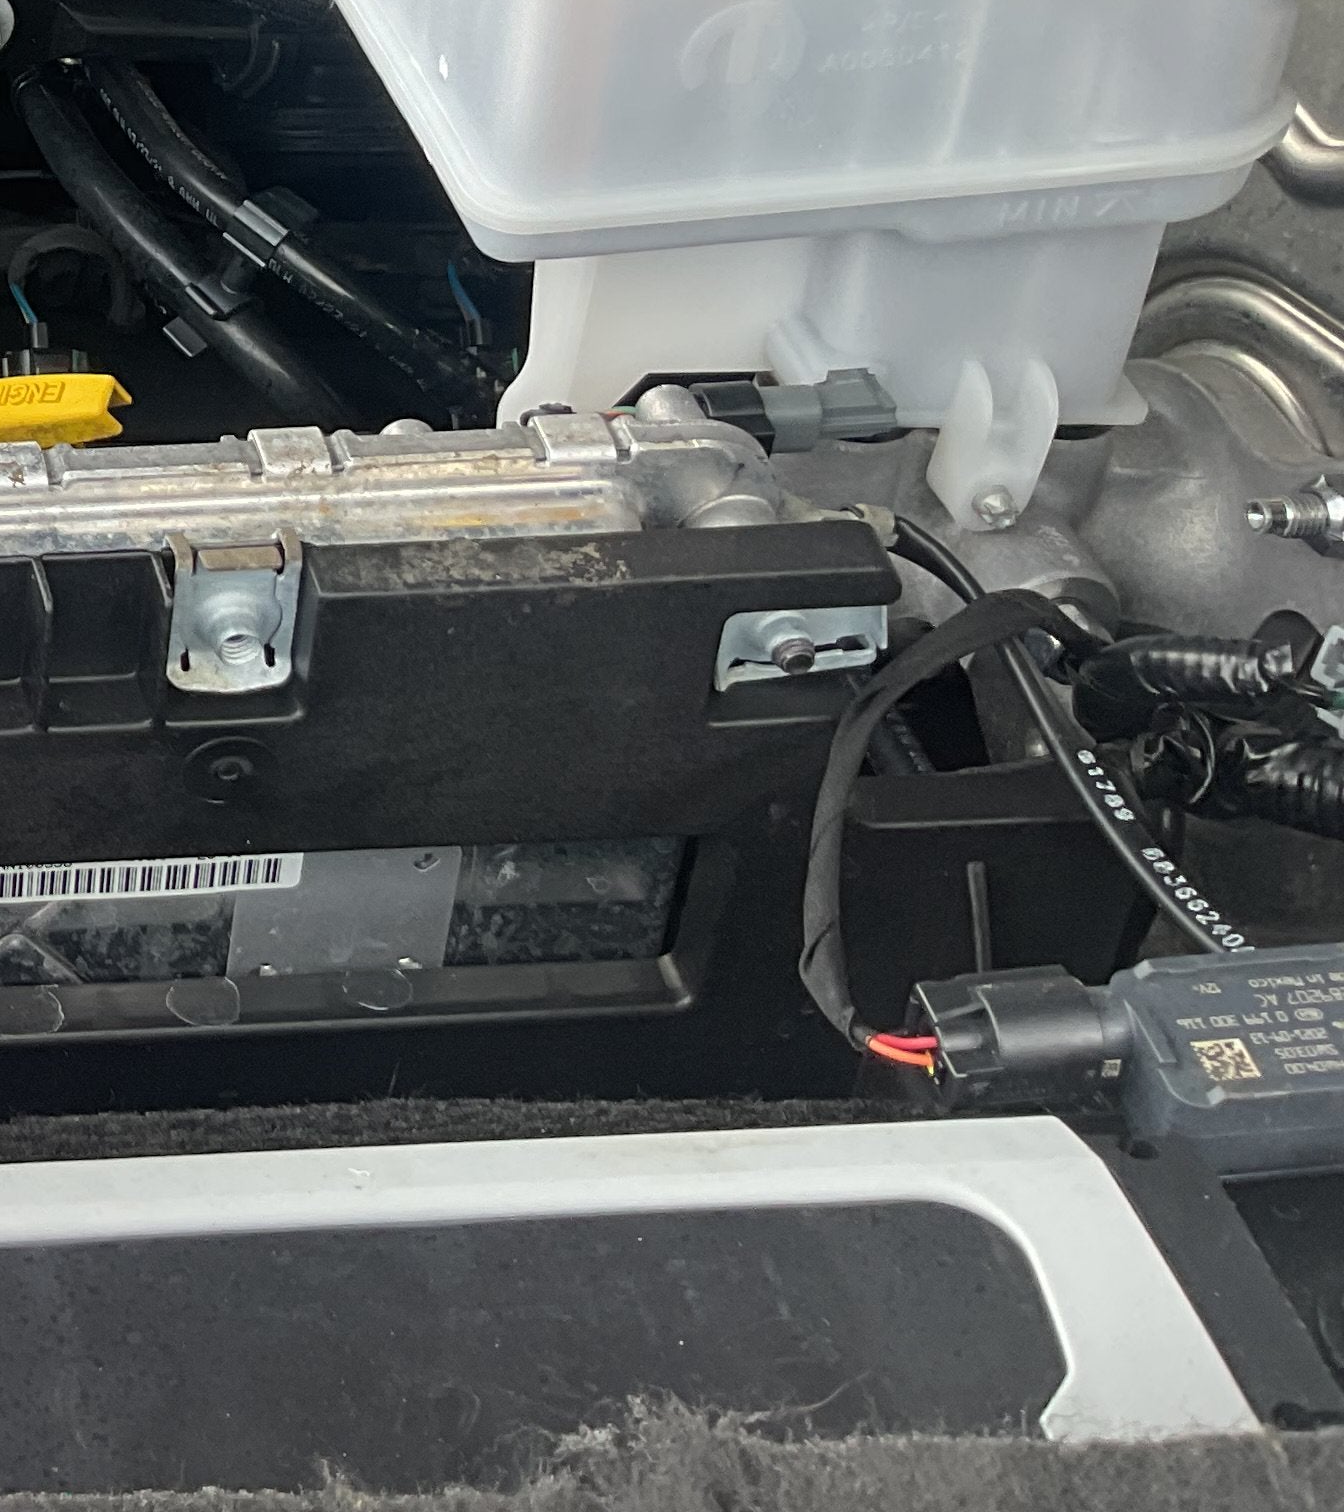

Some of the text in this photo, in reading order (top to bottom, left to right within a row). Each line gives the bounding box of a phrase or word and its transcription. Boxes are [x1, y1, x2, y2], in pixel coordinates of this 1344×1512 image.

[999, 196, 1080, 227] MIN
[1248, 976, 1305, 989] Mexico
[1304, 973, 1325, 984] in
[1254, 993, 1279, 1007] AC
